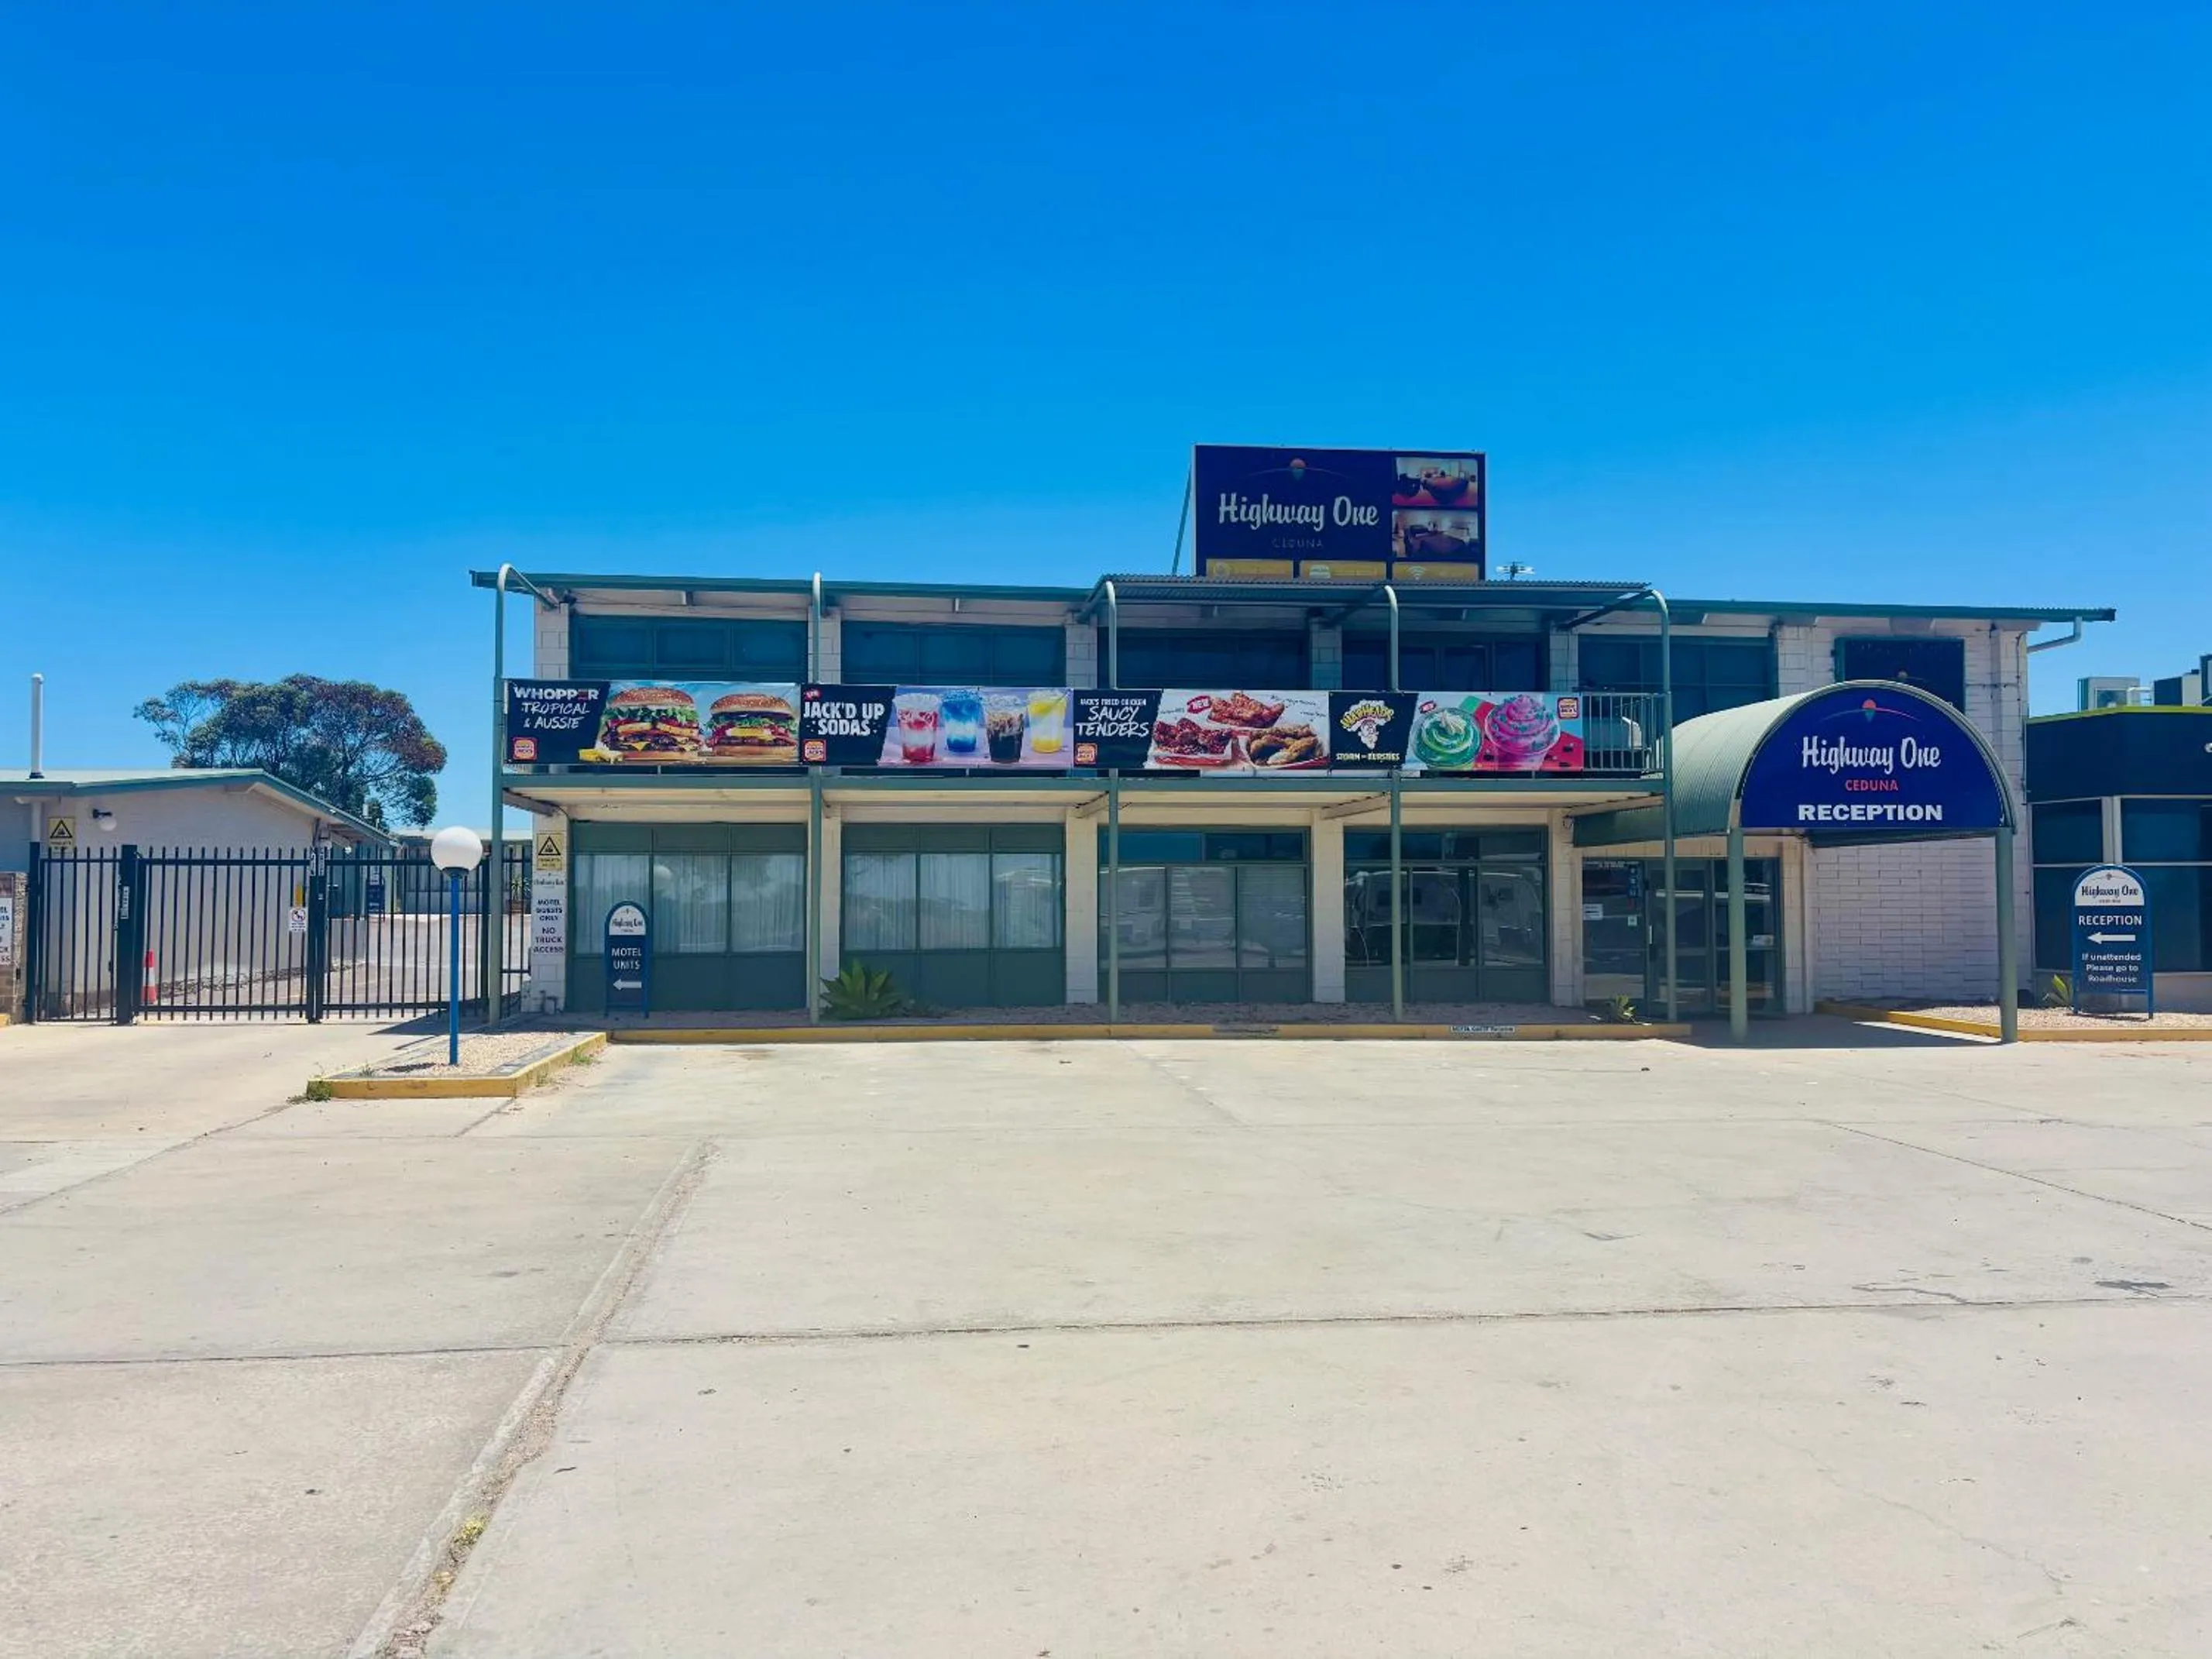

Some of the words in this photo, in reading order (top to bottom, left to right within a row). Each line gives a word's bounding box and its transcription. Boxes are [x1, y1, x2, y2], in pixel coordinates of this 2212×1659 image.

[1218, 493, 1325, 531] Highway
[1333, 496, 1379, 527] One
[521, 701, 590, 714] TROPICAL
[803, 701, 857, 719] JACK'D
[862, 702, 885, 720] UP
[1190, 698, 1211, 711] NEW
[1088, 706, 1139, 722] SAUCY
[523, 717, 531, 728] &
[534, 716, 585, 729] AUSSIE
[818, 718, 871, 736] SODAS
[1075, 722, 1149, 737] TENDERS
[1802, 736, 1894, 775] Highway
[1901, 737, 1942, 768] One
[1845, 780, 1898, 791] CEDUNA
[1798, 804, 1943, 821] RECEPTION
[2081, 885, 2119, 898] Highway
[2121, 884, 2138, 896] One
[2079, 915, 2142, 926] RECEPTION
[611, 948, 642, 957] MOTEL
[613, 960, 641, 970] UNITS
